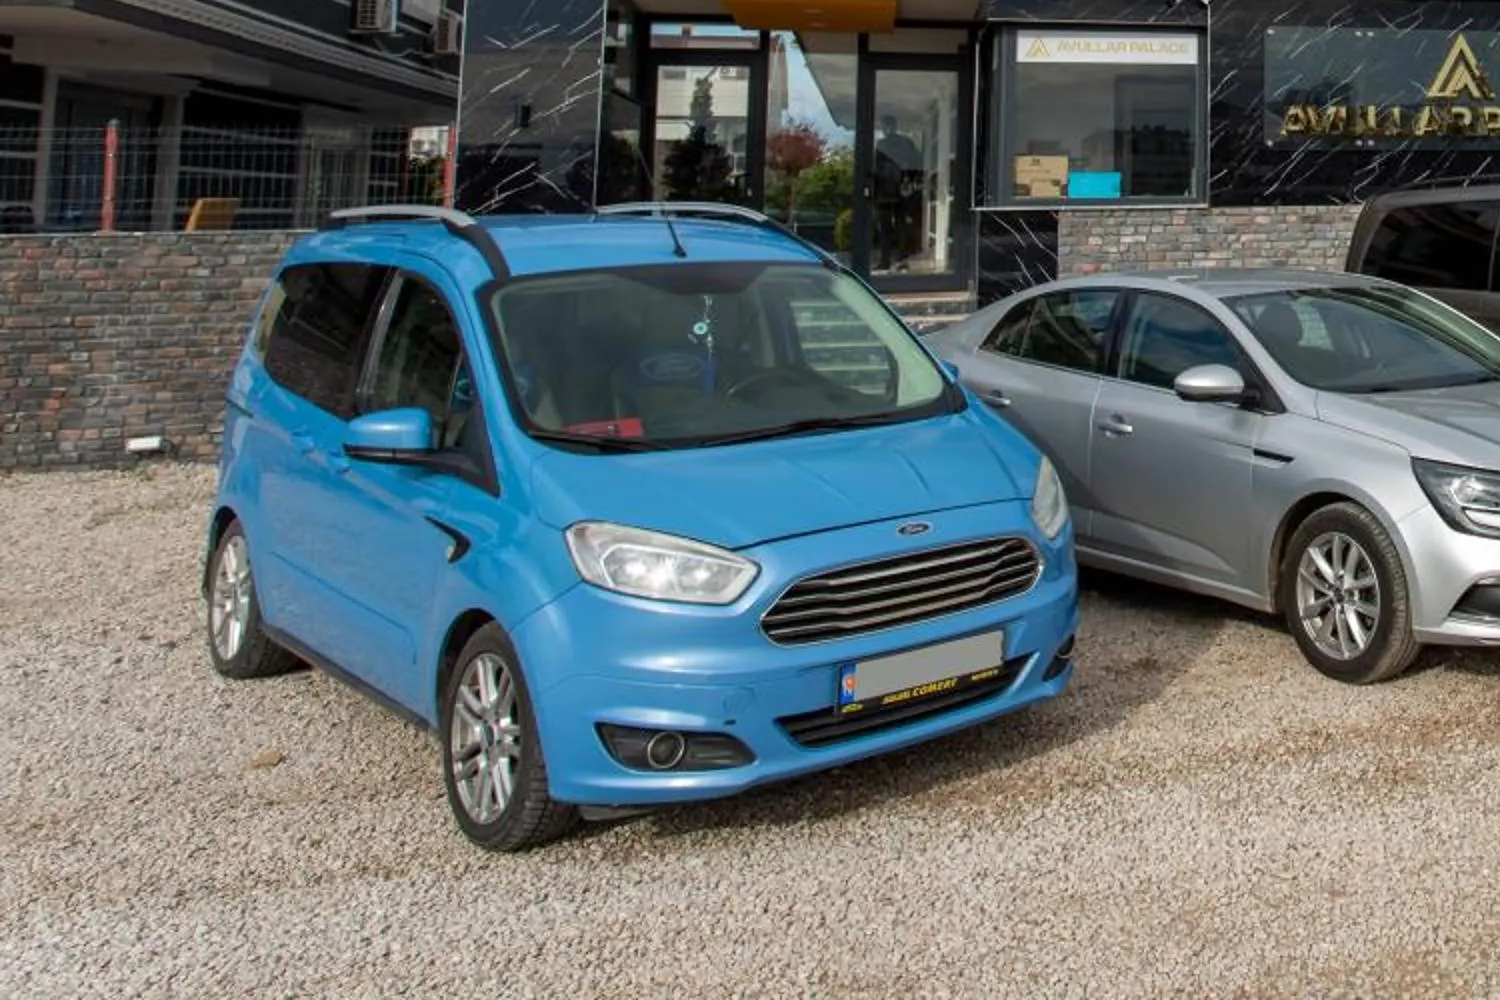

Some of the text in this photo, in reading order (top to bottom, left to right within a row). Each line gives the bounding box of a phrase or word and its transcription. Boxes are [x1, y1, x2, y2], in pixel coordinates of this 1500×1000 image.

[1056, 39, 1189, 55] AVULLAR PALACE
[1279, 104, 1474, 138] AVULLAR
